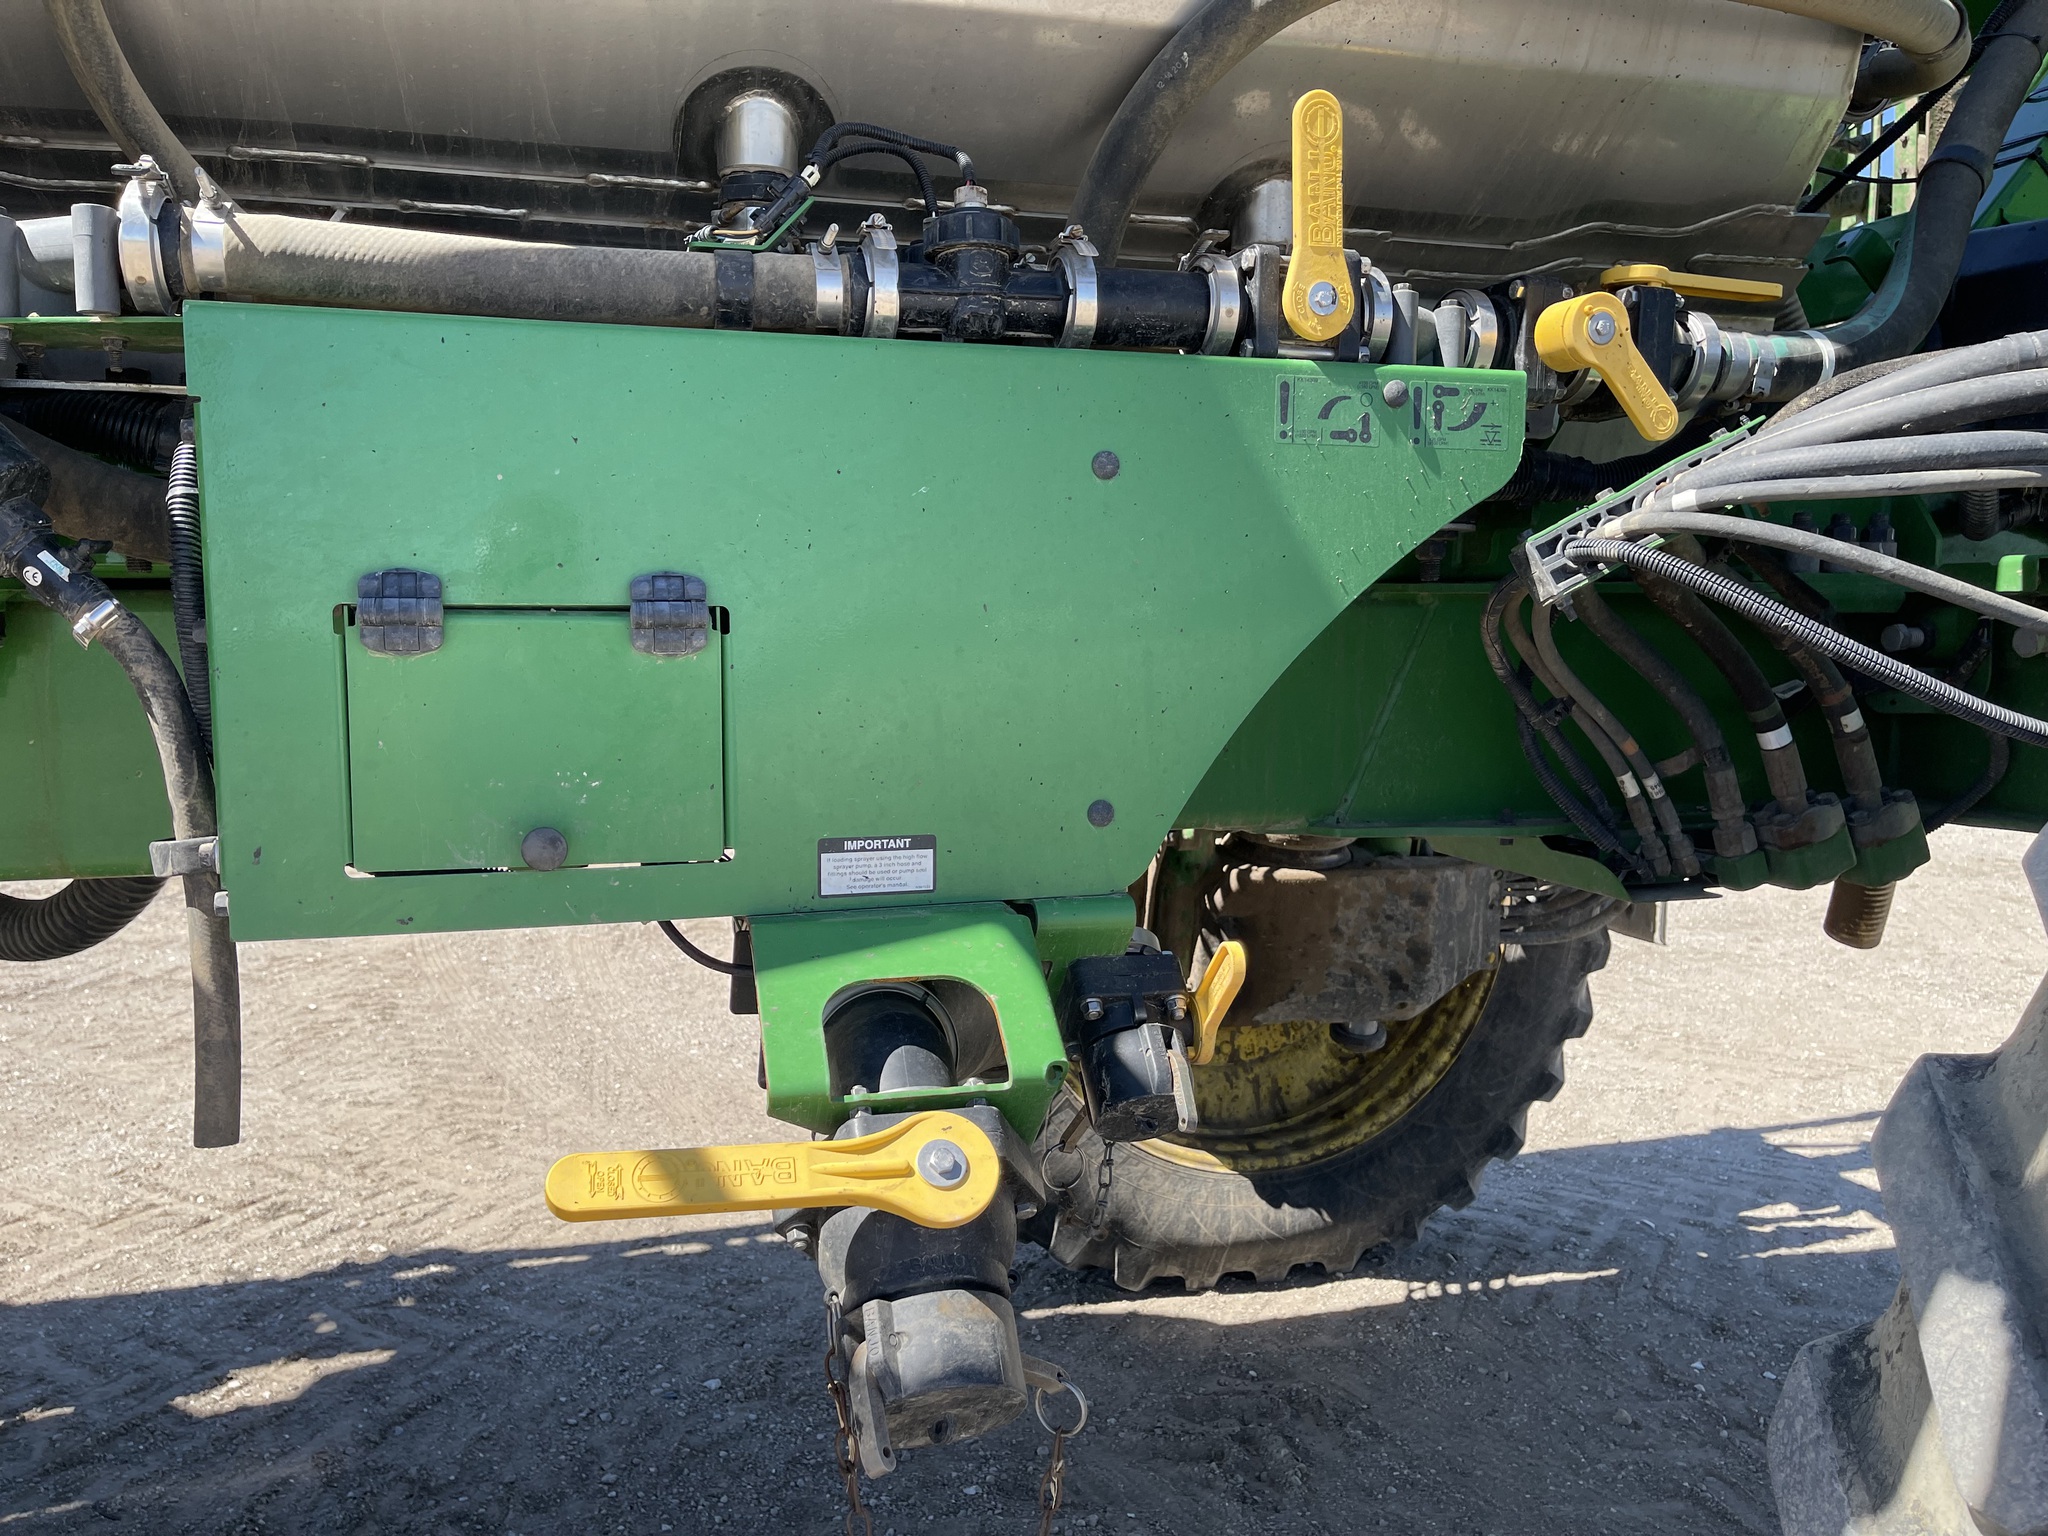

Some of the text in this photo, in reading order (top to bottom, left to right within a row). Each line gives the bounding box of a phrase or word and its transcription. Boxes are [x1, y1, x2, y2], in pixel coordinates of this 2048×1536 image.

[844, 838, 911, 850] IMPORTANT
[832, 856, 853, 864] loading
[858, 882, 886, 890] operator's
[596, 1170, 605, 1193] OPEN
[863, 1306, 880, 1357] BANJO
